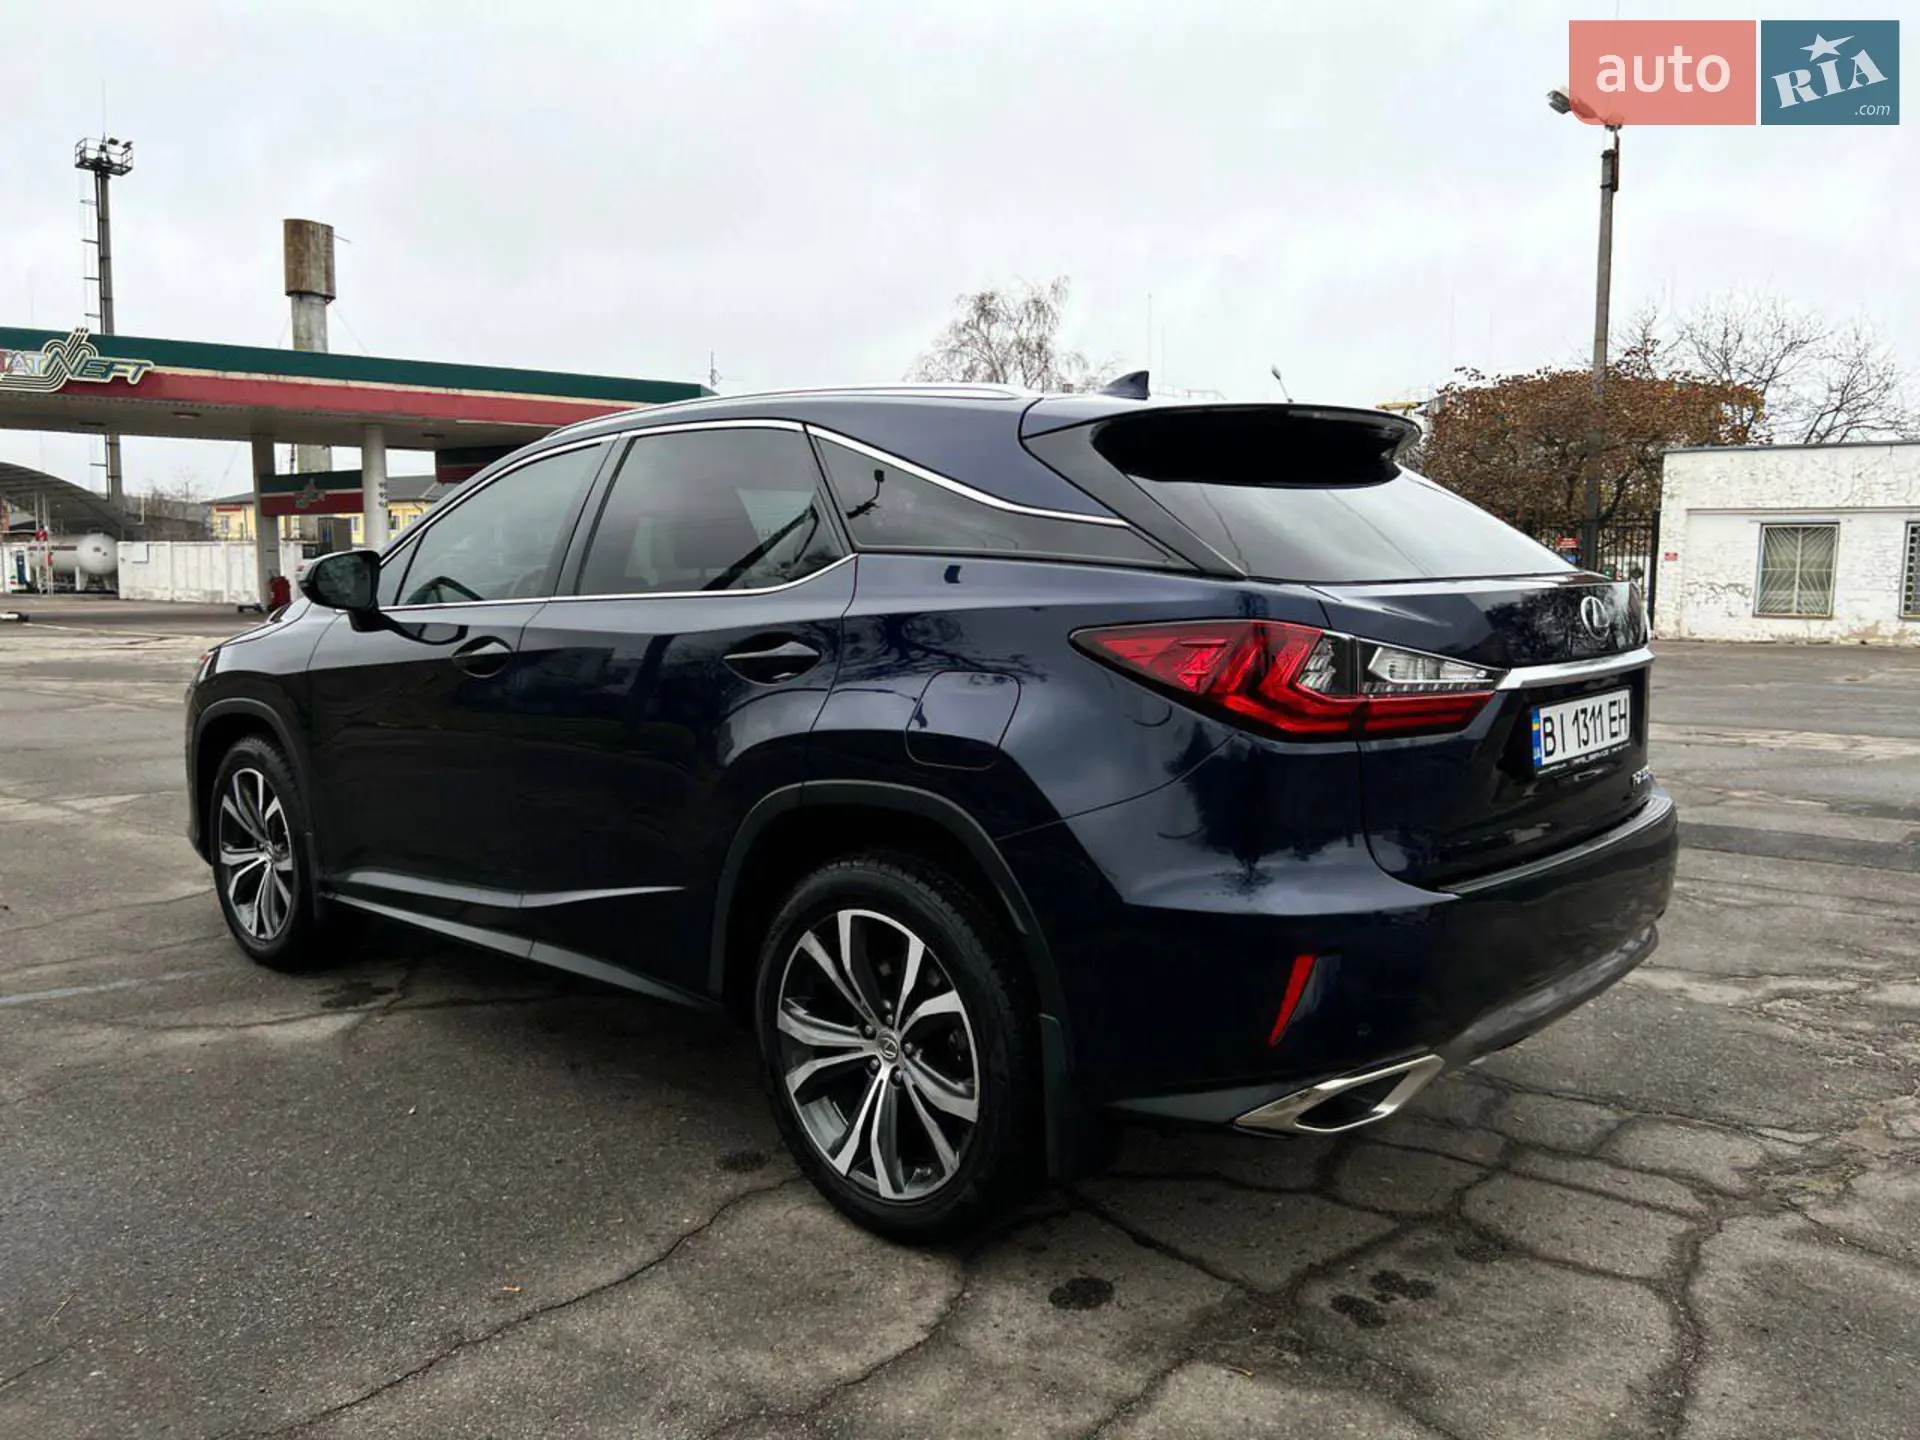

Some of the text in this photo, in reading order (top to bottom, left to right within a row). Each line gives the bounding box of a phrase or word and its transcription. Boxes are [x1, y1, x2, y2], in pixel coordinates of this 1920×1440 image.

[1543, 712, 1566, 757] BI
[1572, 704, 1604, 748] 1311
[1608, 697, 1628, 739] EH
